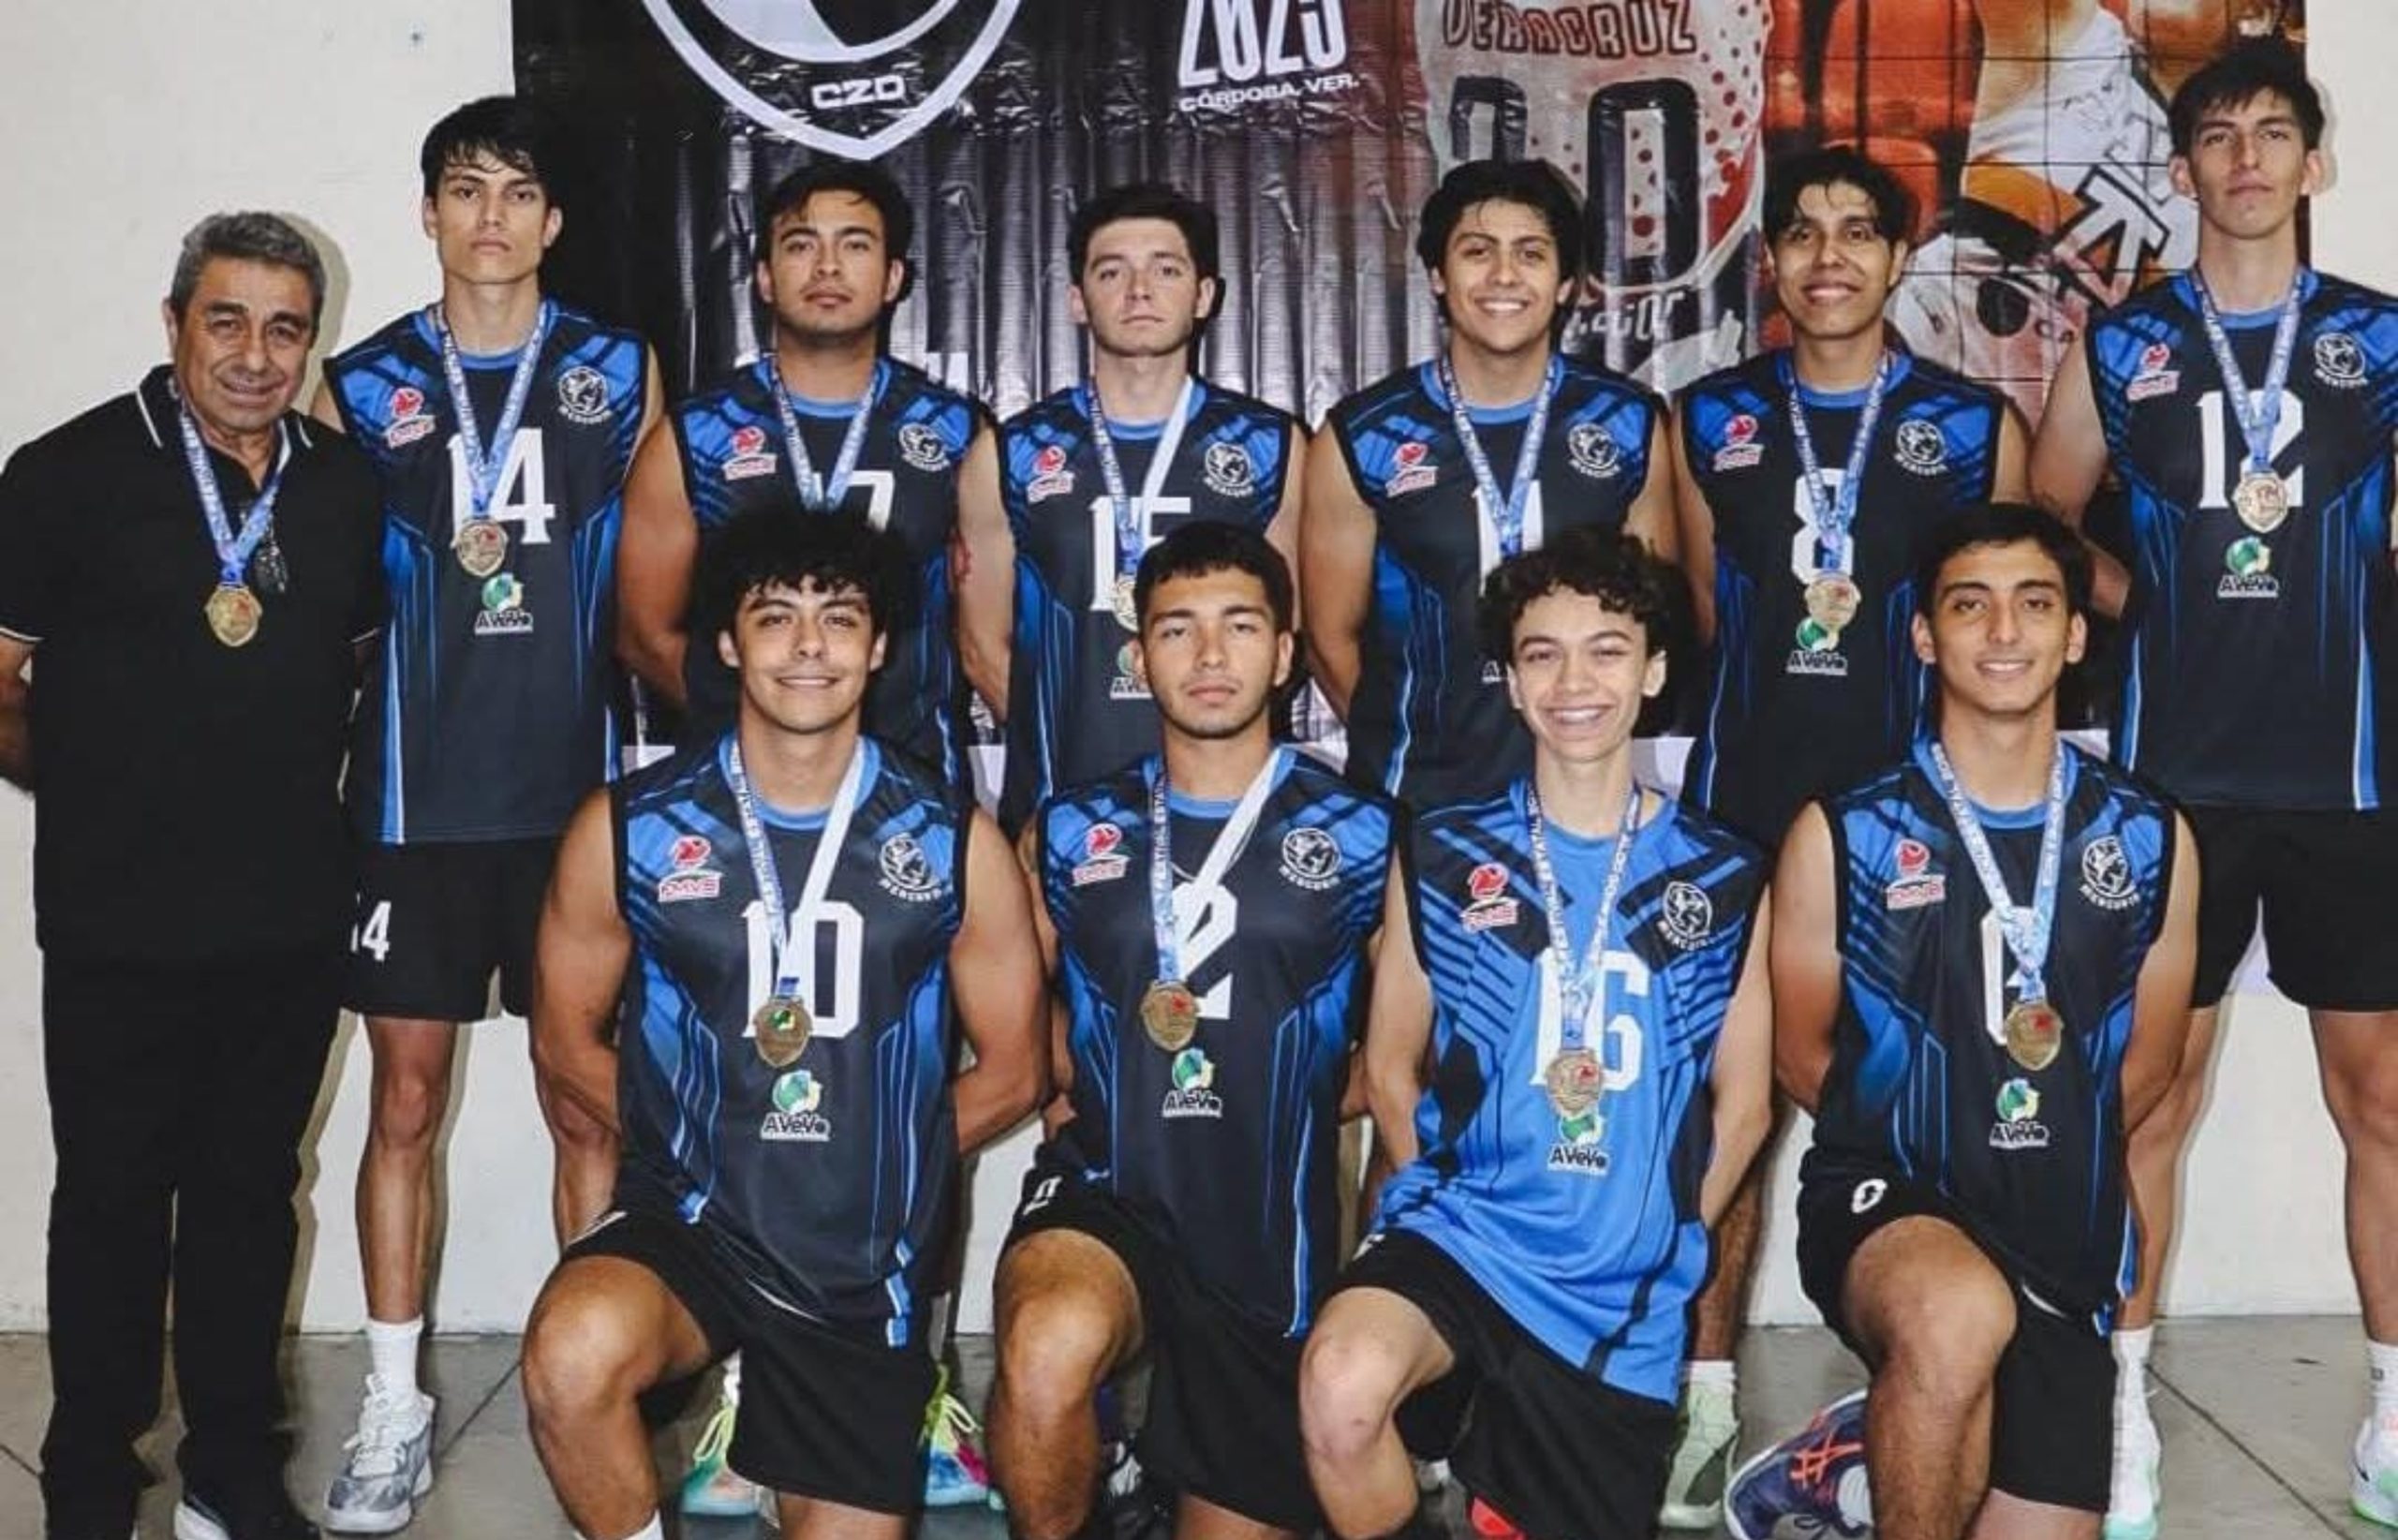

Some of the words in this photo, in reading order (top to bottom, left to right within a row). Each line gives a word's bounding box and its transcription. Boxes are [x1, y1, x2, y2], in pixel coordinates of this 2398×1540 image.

[447, 427, 555, 549] 14
[2196, 389, 2303, 509] 12
[1791, 468, 1858, 585] 8
[741, 900, 864, 1038] 10
[1171, 881, 1237, 1020] 2
[1530, 947, 1650, 1092] 16
